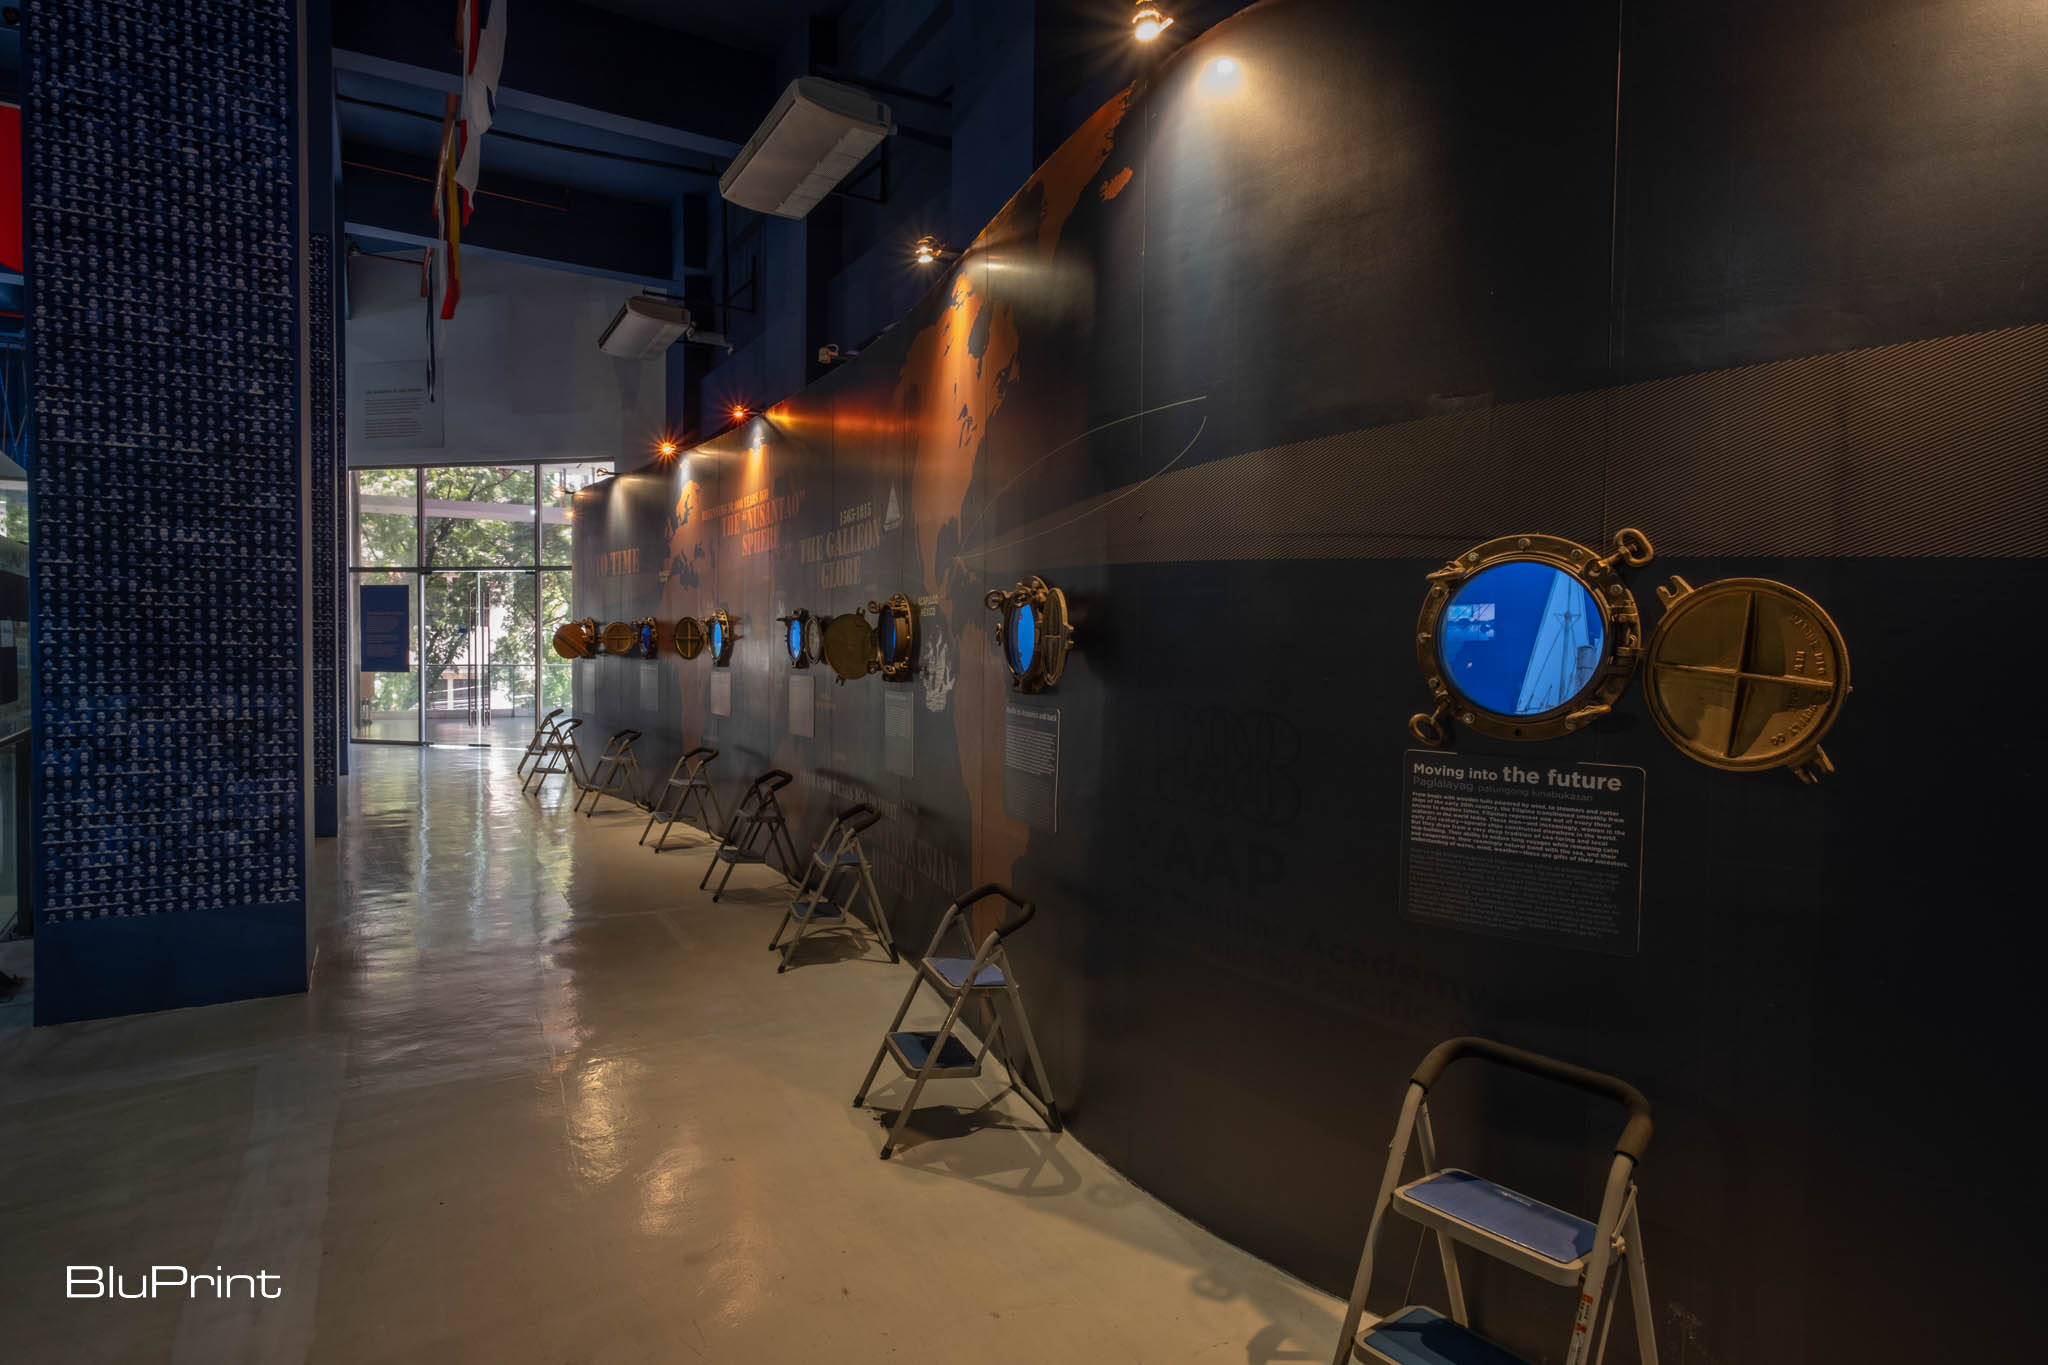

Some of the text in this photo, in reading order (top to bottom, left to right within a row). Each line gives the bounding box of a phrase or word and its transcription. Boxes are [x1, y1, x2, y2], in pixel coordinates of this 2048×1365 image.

[799, 518, 881, 565] THE GALLEON
[820, 555, 863, 591] GLOBE
[1413, 762, 1623, 792] Moving into the future
